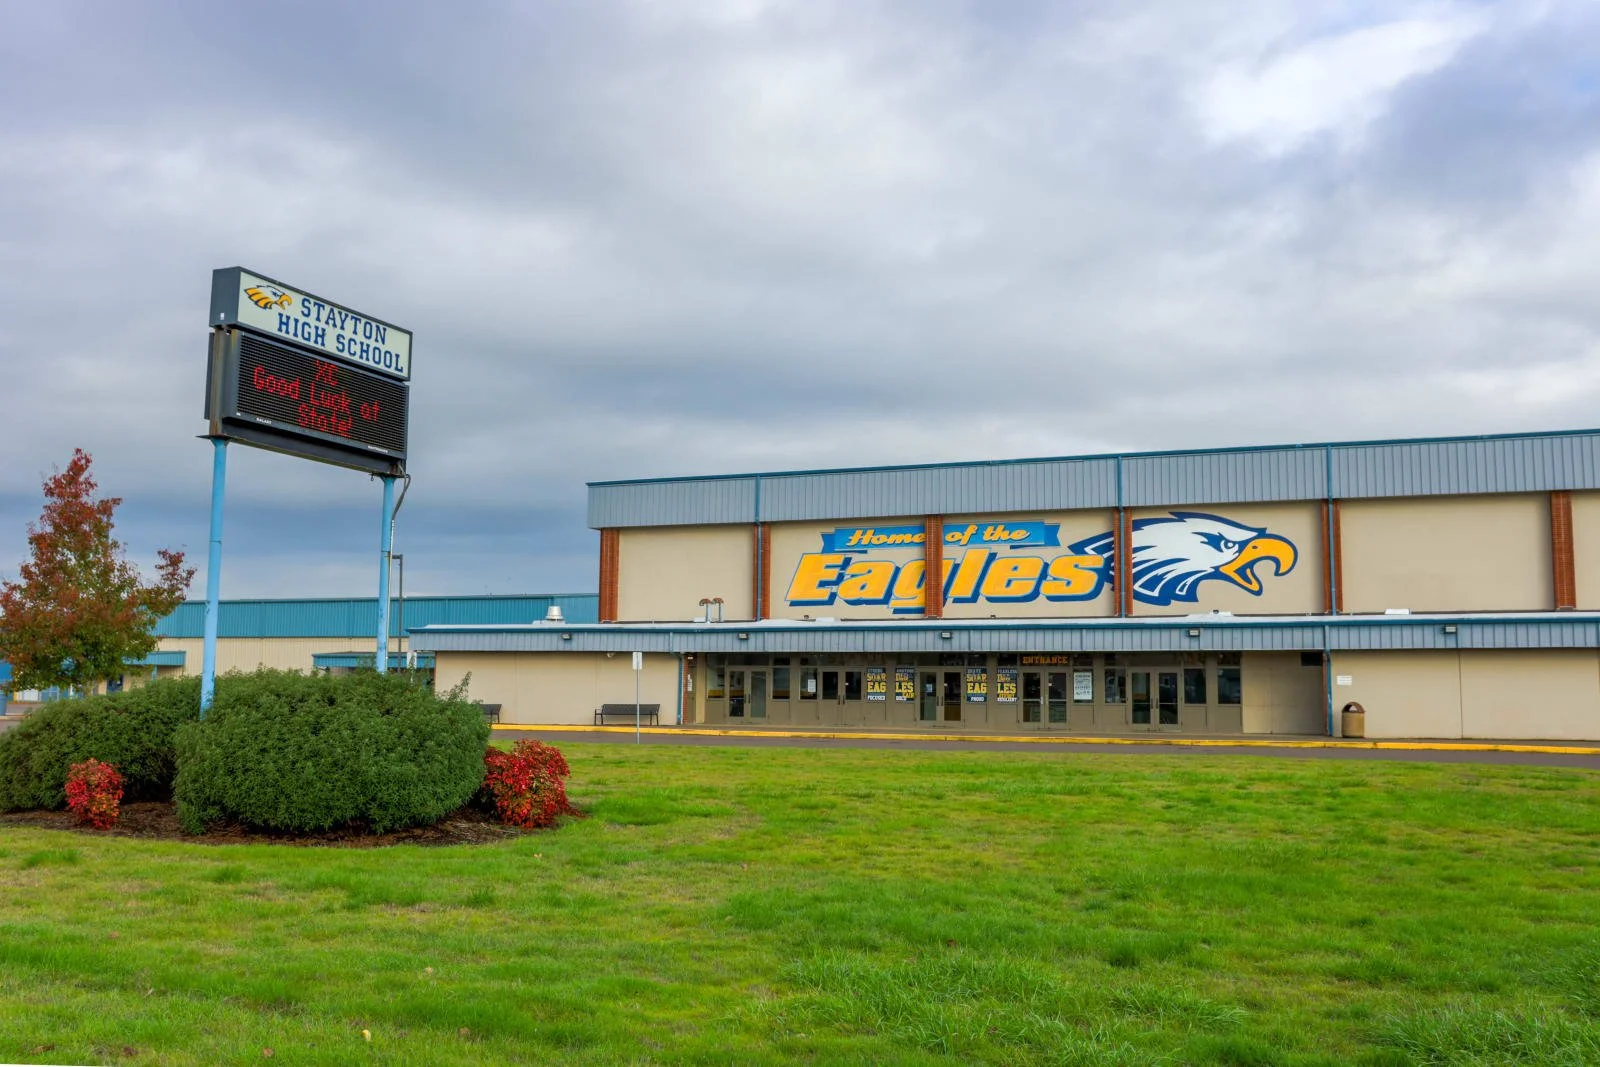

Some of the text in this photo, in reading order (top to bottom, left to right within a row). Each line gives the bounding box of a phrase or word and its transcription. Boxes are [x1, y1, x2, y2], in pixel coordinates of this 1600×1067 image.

[301, 297, 387, 345] STAYTON
[277, 312, 403, 373] HIGH SCHOOL
[314, 359, 338, 387] XC
[253, 365, 300, 400] Good
[310, 382, 351, 415] Luck
[847, 524, 1029, 546] Home of the
[785, 547, 1105, 612] Eagles
[1022, 656, 1069, 664] ENTRANCE
[867, 681, 887, 693] EAG
[895, 681, 914, 693] LES
[967, 682, 987, 694] EAG
[997, 682, 1017, 694] LES
